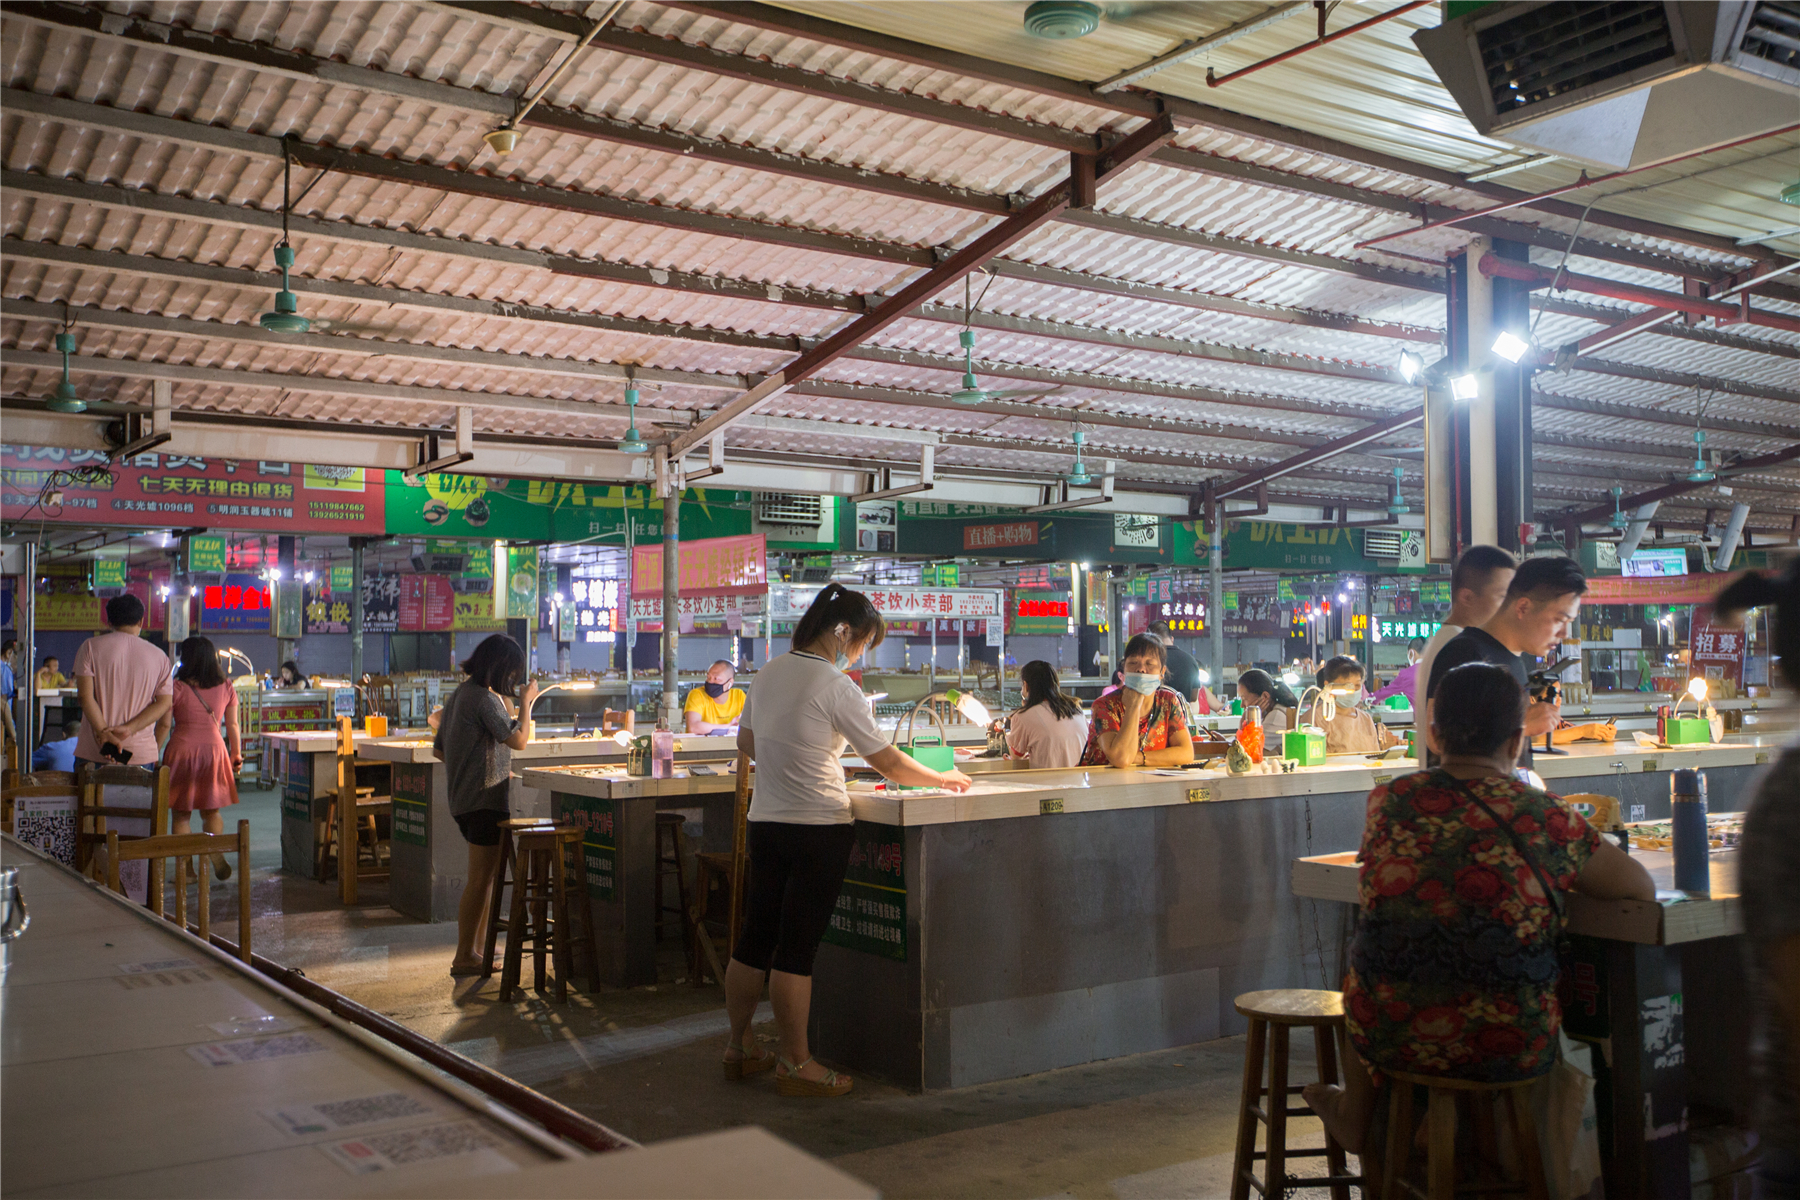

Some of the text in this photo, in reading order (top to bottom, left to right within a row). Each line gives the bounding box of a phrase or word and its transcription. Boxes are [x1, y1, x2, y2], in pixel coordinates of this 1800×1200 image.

[139, 475, 293, 500] 七天无理由退货
[635, 523, 664, 536] 任您
[969, 525, 1032, 546] 直播+购物
[637, 543, 759, 592] 怡源天光墟经销点
[1148, 579, 1171, 601] F区
[1695, 633, 1738, 653] 招募
